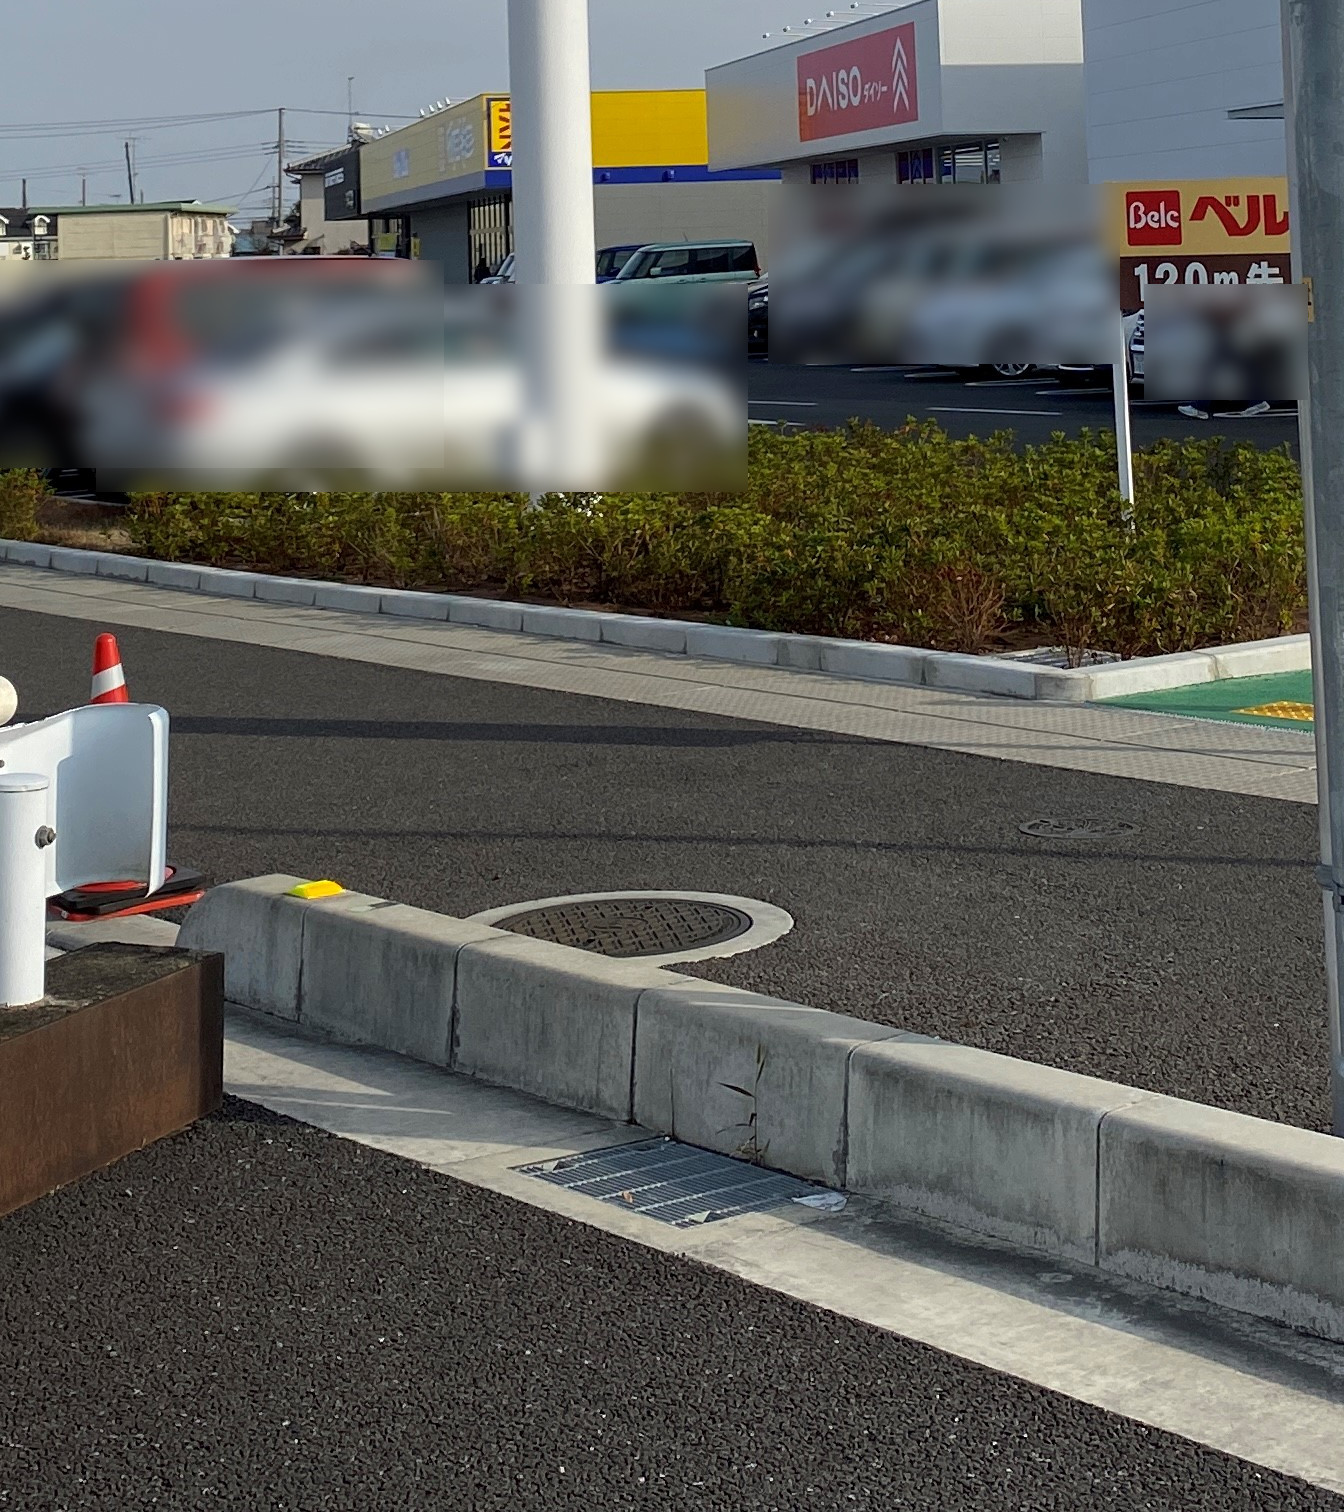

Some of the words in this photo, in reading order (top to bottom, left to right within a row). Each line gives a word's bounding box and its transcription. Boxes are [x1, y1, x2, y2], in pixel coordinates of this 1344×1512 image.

[806, 66, 861, 116] DAISO
[1129, 201, 1179, 229] Belc
[1189, 194, 1289, 236] ベル
